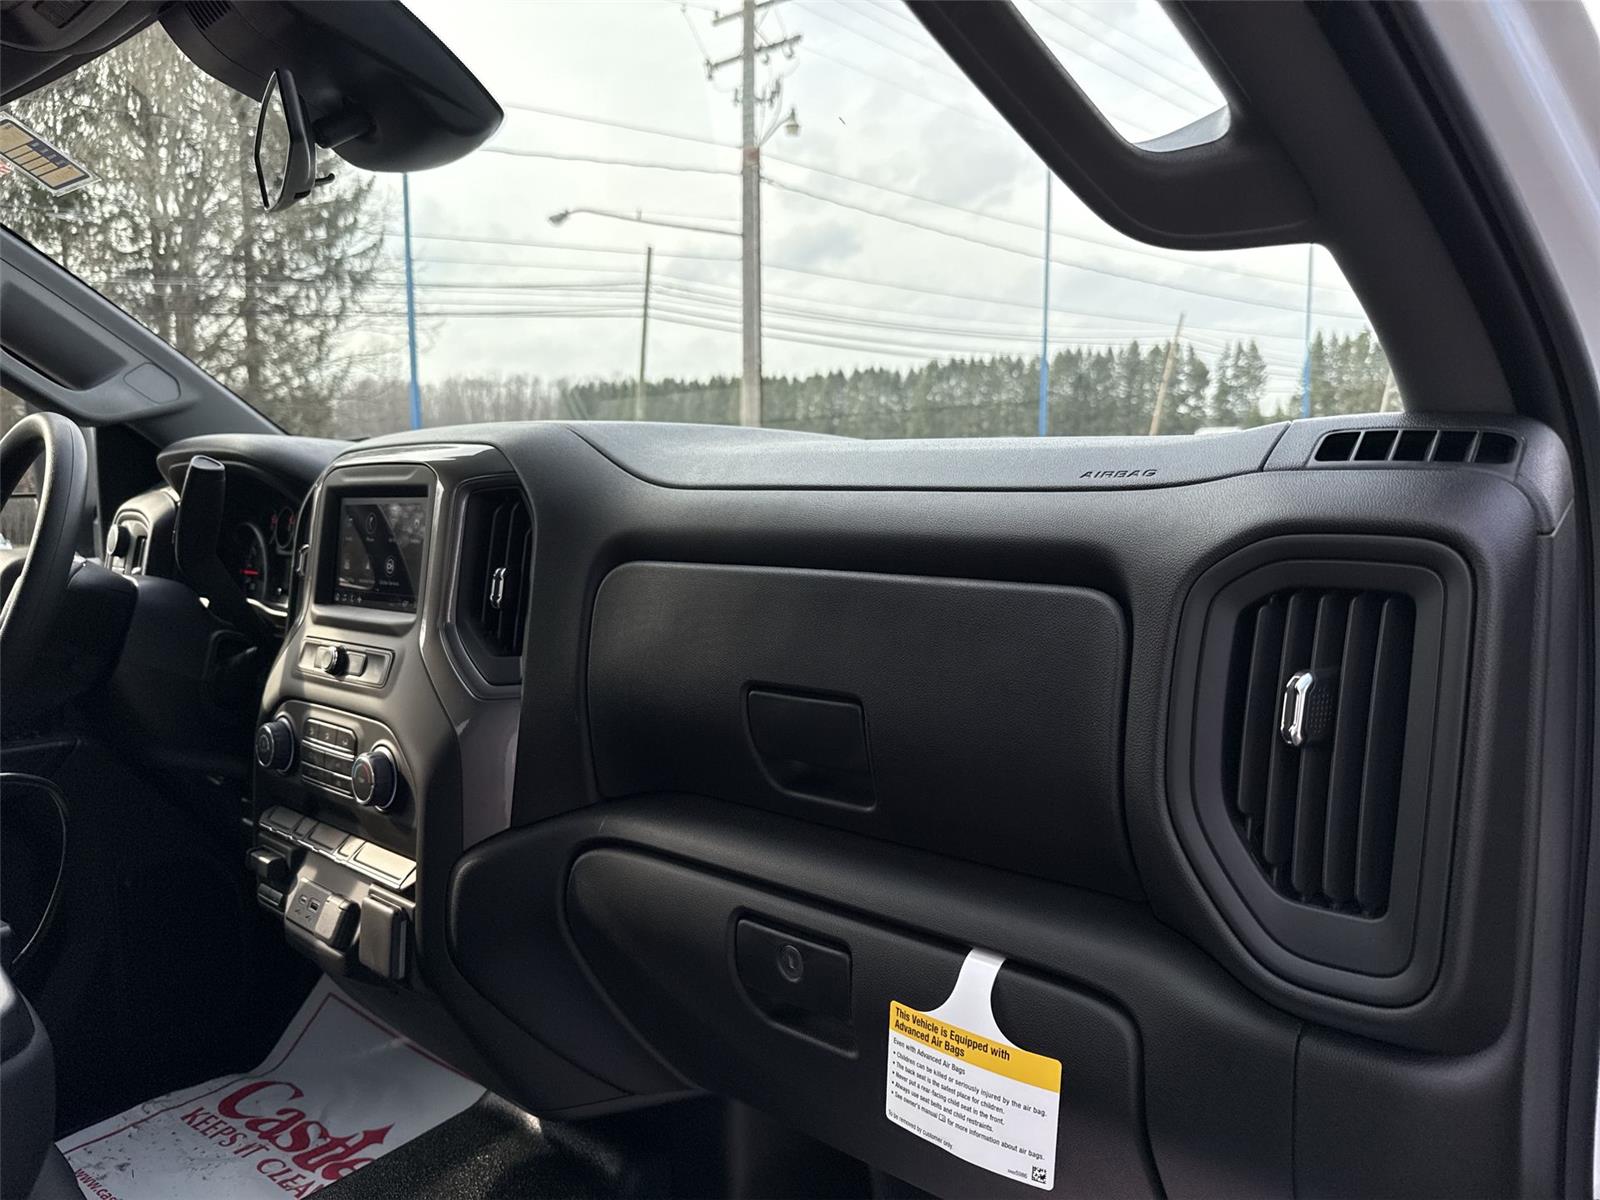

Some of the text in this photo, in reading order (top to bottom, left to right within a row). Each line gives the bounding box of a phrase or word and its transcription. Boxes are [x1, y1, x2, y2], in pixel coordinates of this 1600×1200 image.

[1080, 469, 1158, 478] AIRBAG
[894, 1038, 904, 1047] Even
[906, 1044, 916, 1054] with
[917, 1049, 942, 1064] Advanced
[952, 1064, 966, 1074] Bags
[895, 1020, 964, 1056] Advanced Air Bags
[896, 1006, 1010, 1061] This Vehicle is Equipped with
[895, 1082, 910, 1094] Always
[920, 1095, 930, 1104] seat
[930, 1100, 942, 1110] belts
[953, 1112, 966, 1121] child
[966, 1118, 994, 1132] restraints.
[896, 1071, 908, 1082] Never
[921, 1085, 946, 1102] rear-facing
[948, 1098, 960, 1108] child
[960, 1104, 972, 1112] seat
[980, 1111, 988, 1119] the
[990, 1114, 1005, 1125] front.
[897, 1052, 915, 1065] Children
[934, 1070, 947, 1080] killed
[955, 1080, 980, 1094] seriously
[980, 1089, 1001, 1102] injured
[1002, 1097, 1010, 1106] by
[1012, 1100, 1021, 1108] the
[1033, 1107, 1047, 1117] bag.
[905, 1066, 915, 1076] back
[916, 1073, 926, 1081] seat
[940, 1084, 956, 1095] safest
[957, 1092, 970, 1101] place
[972, 1096, 980, 1104] for
[980, 1100, 1005, 1114] children.
[181, 1107, 247, 1148] KEEPS
[234, 1142, 270, 1158] IT
[218, 1081, 395, 1180] Castle
[899, 1117, 916, 1130] removed
[916, 1126, 922, 1134] by
[922, 1130, 942, 1143] customer
[904, 1097, 920, 1109] owner's
[921, 1106, 938, 1118] manual
[955, 1123, 968, 1132] more
[969, 1128, 1000, 1144] information
[1001, 1141, 1018, 1152] about
[1028, 1150, 1045, 1160] bags.
